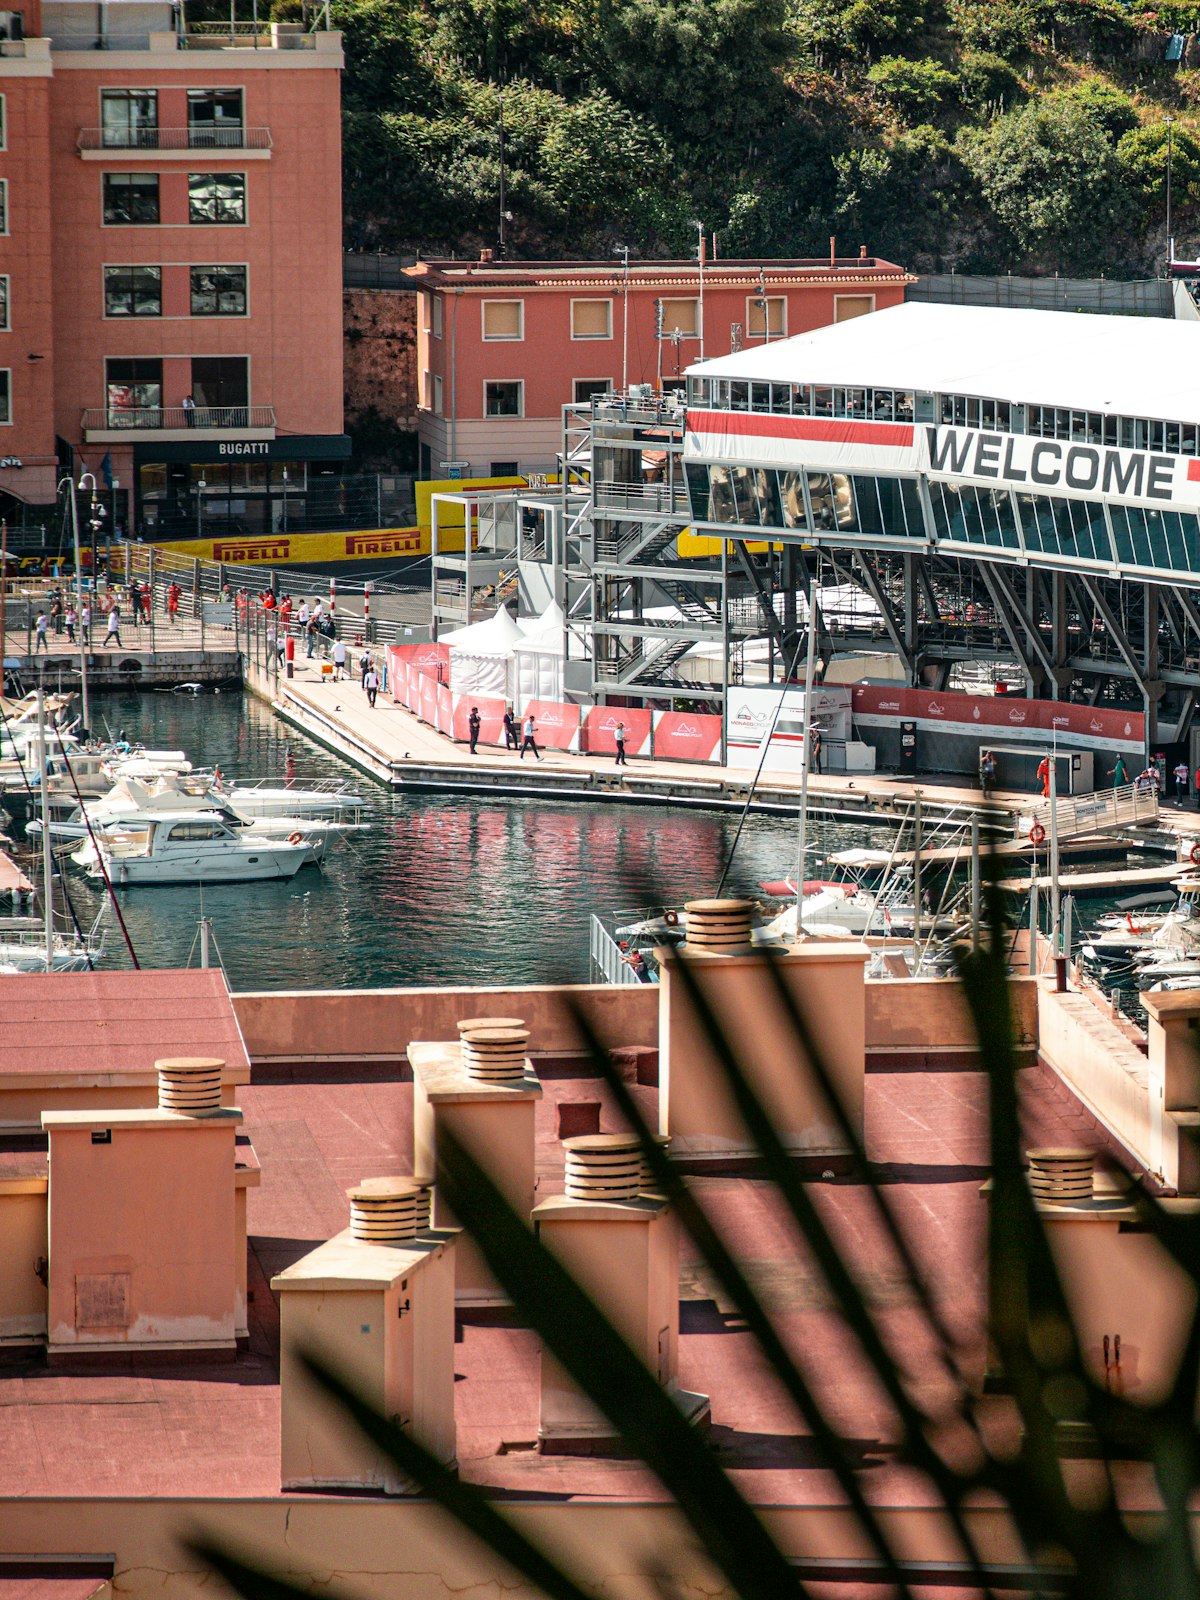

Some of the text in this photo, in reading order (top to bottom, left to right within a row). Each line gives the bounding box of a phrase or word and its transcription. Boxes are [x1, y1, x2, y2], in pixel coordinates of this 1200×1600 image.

[219, 443, 269, 454] BUGATTI
[926, 427, 1176, 500] WELCOME
[213, 539, 290, 561] PIRELLI
[346, 531, 421, 554] PIRELLI
